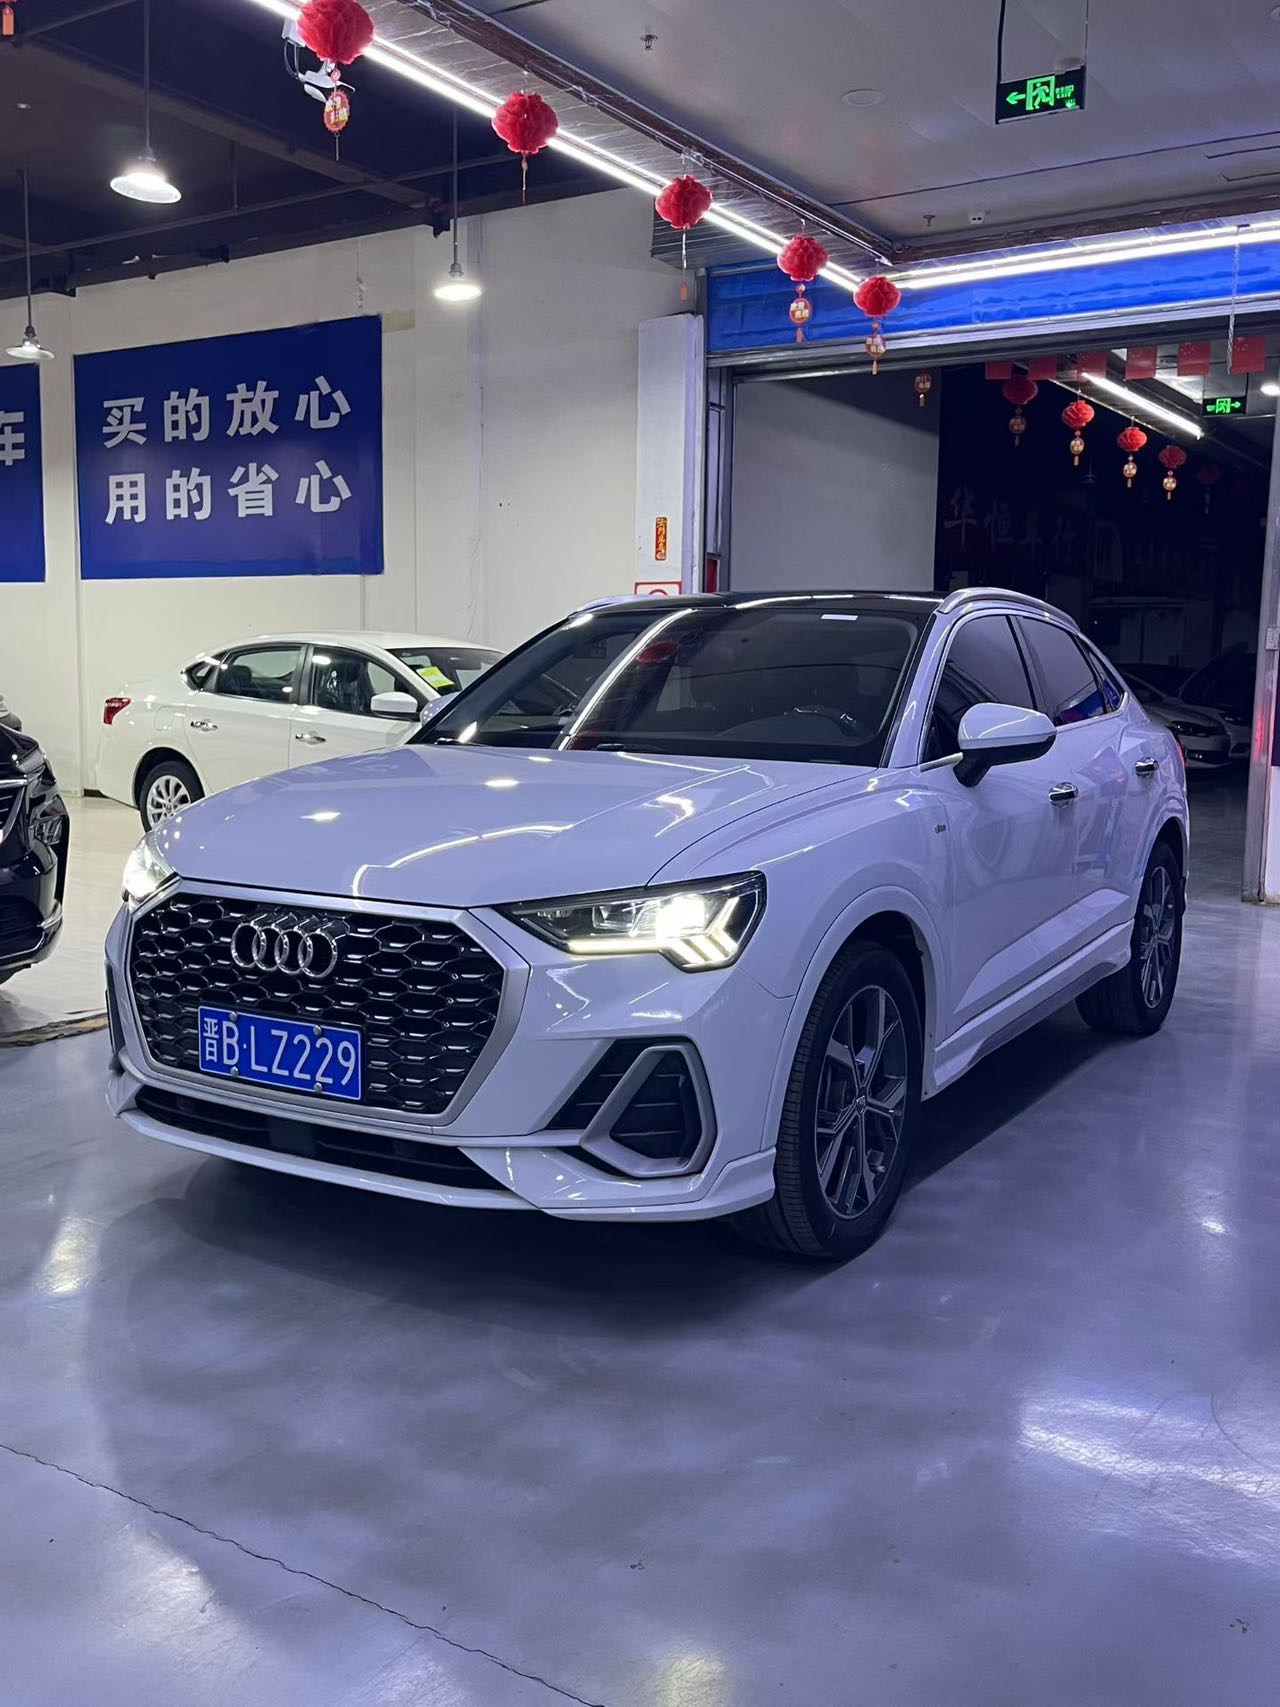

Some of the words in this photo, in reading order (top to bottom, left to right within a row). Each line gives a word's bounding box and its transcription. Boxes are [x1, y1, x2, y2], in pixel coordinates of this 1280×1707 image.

[102, 376, 351, 448] 买的放心
[105, 460, 352, 525] 用的省心
